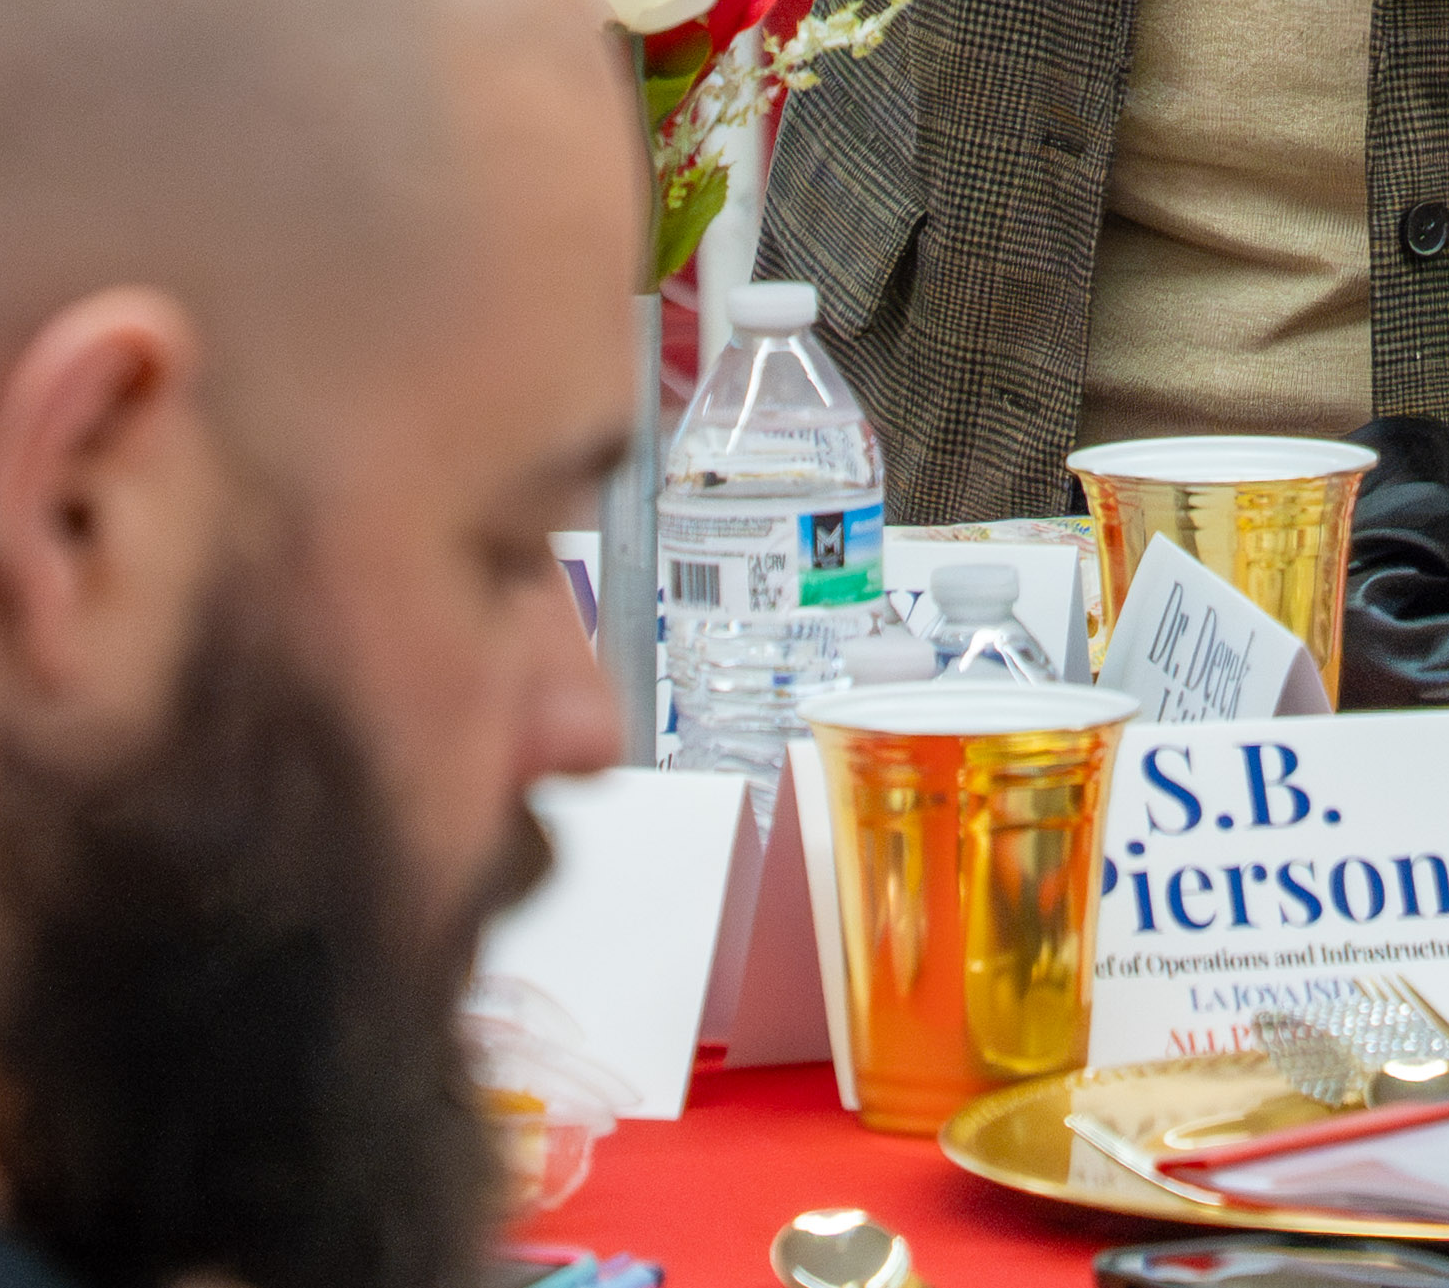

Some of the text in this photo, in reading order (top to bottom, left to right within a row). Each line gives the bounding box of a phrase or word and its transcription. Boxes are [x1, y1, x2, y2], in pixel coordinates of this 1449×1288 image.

[1148, 580, 1255, 721] Dr. Derek
[1140, 741, 1343, 837] S.B.
[1120, 951, 1142, 977] of
[1146, 946, 1270, 980] Operations
[1275, 943, 1315, 968] and
